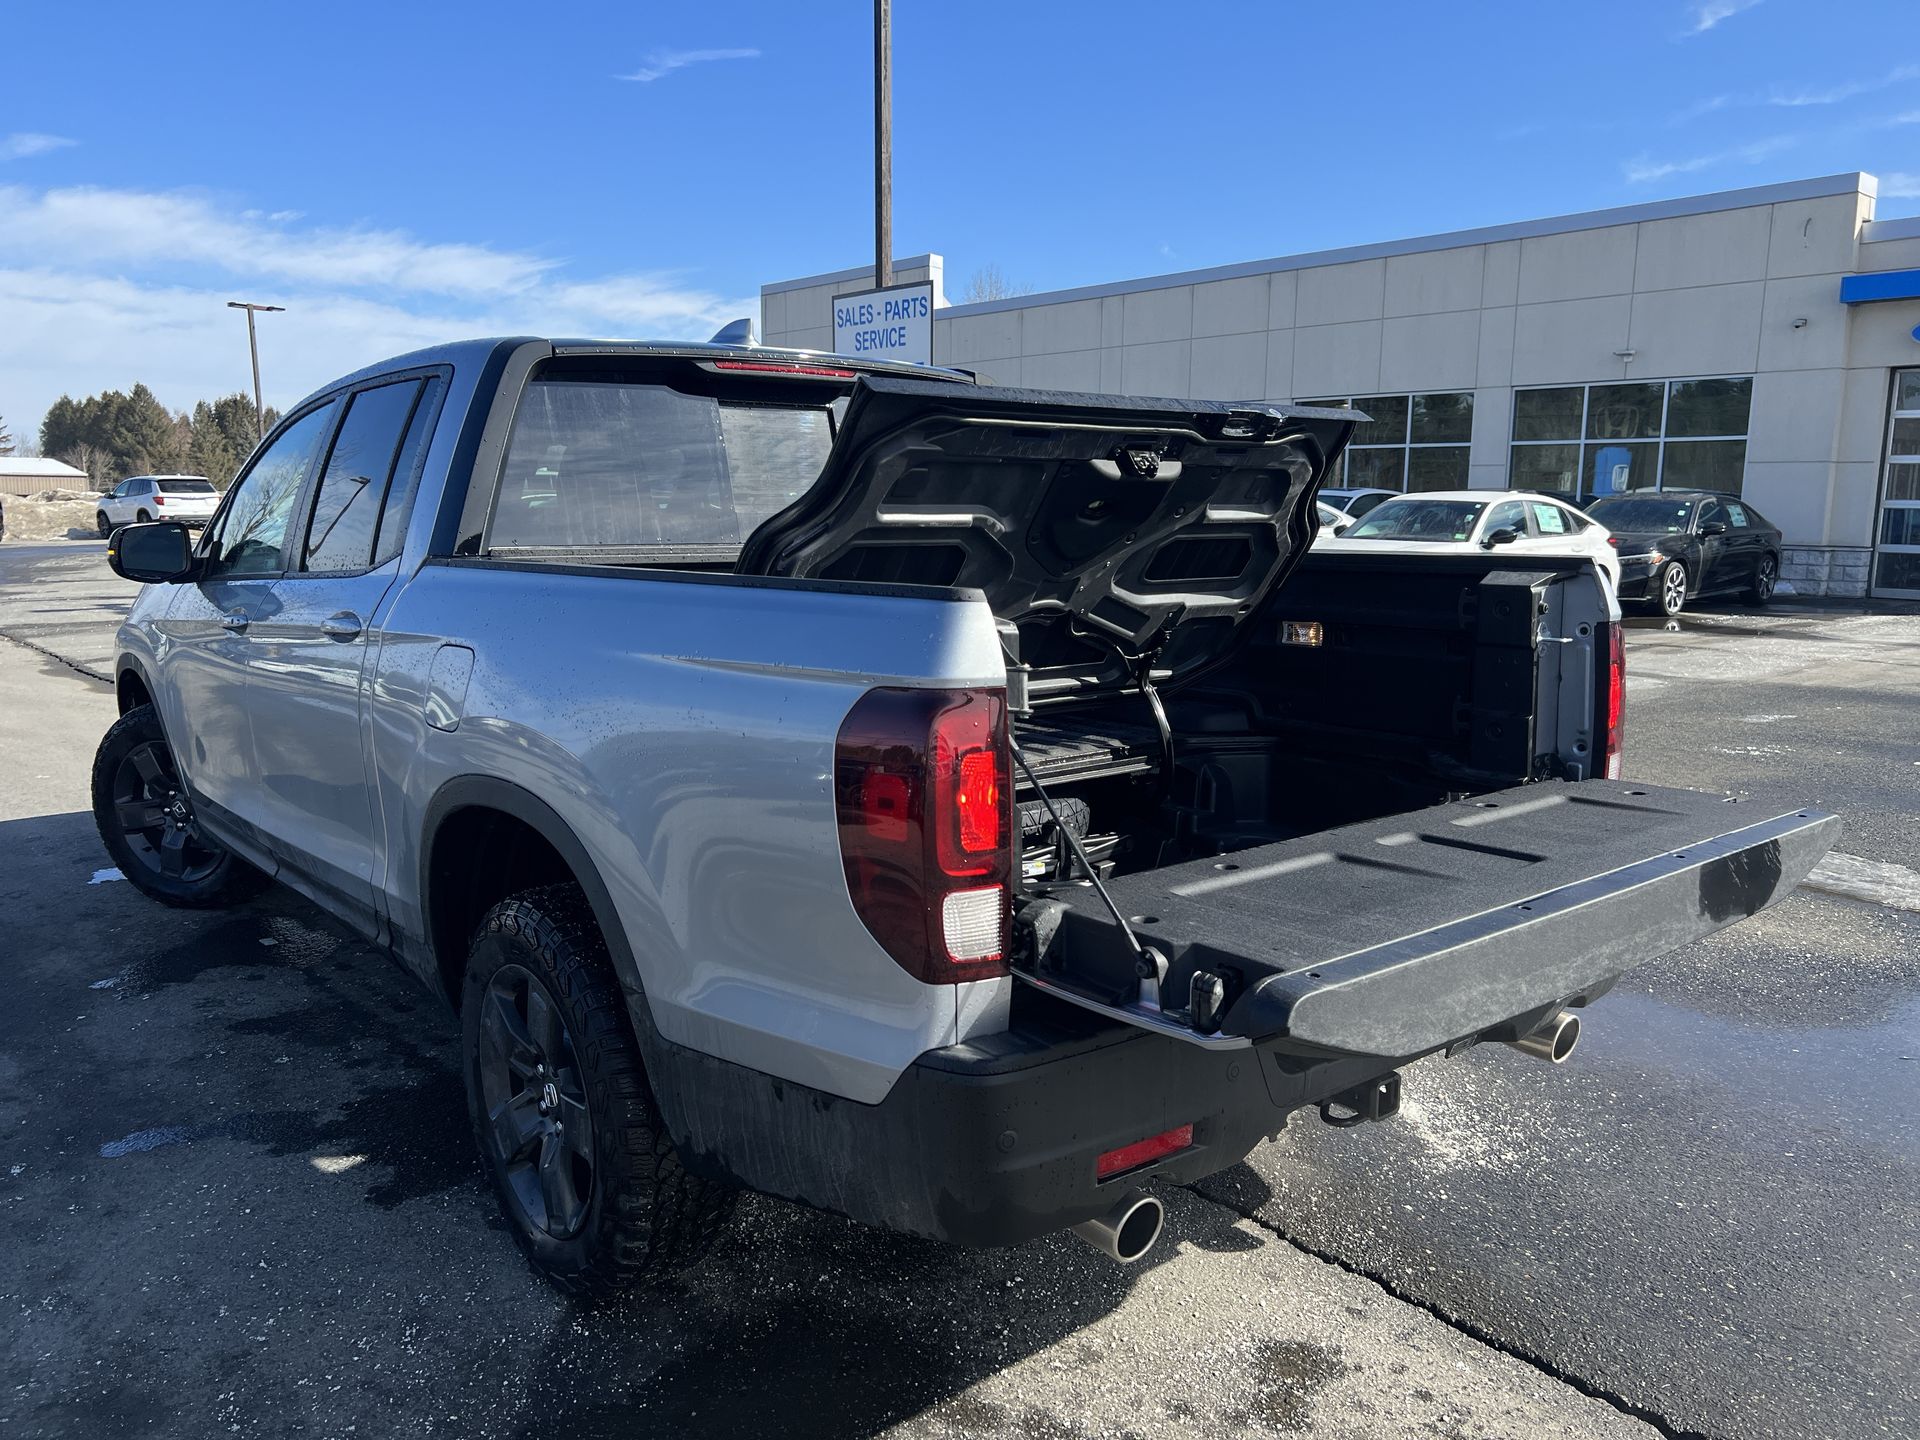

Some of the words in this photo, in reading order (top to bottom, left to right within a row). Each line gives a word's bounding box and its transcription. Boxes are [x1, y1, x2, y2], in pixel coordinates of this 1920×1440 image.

[837, 304, 874, 328] SALES
[885, 296, 928, 321] PARTS
[855, 326, 906, 351] SERVICE
